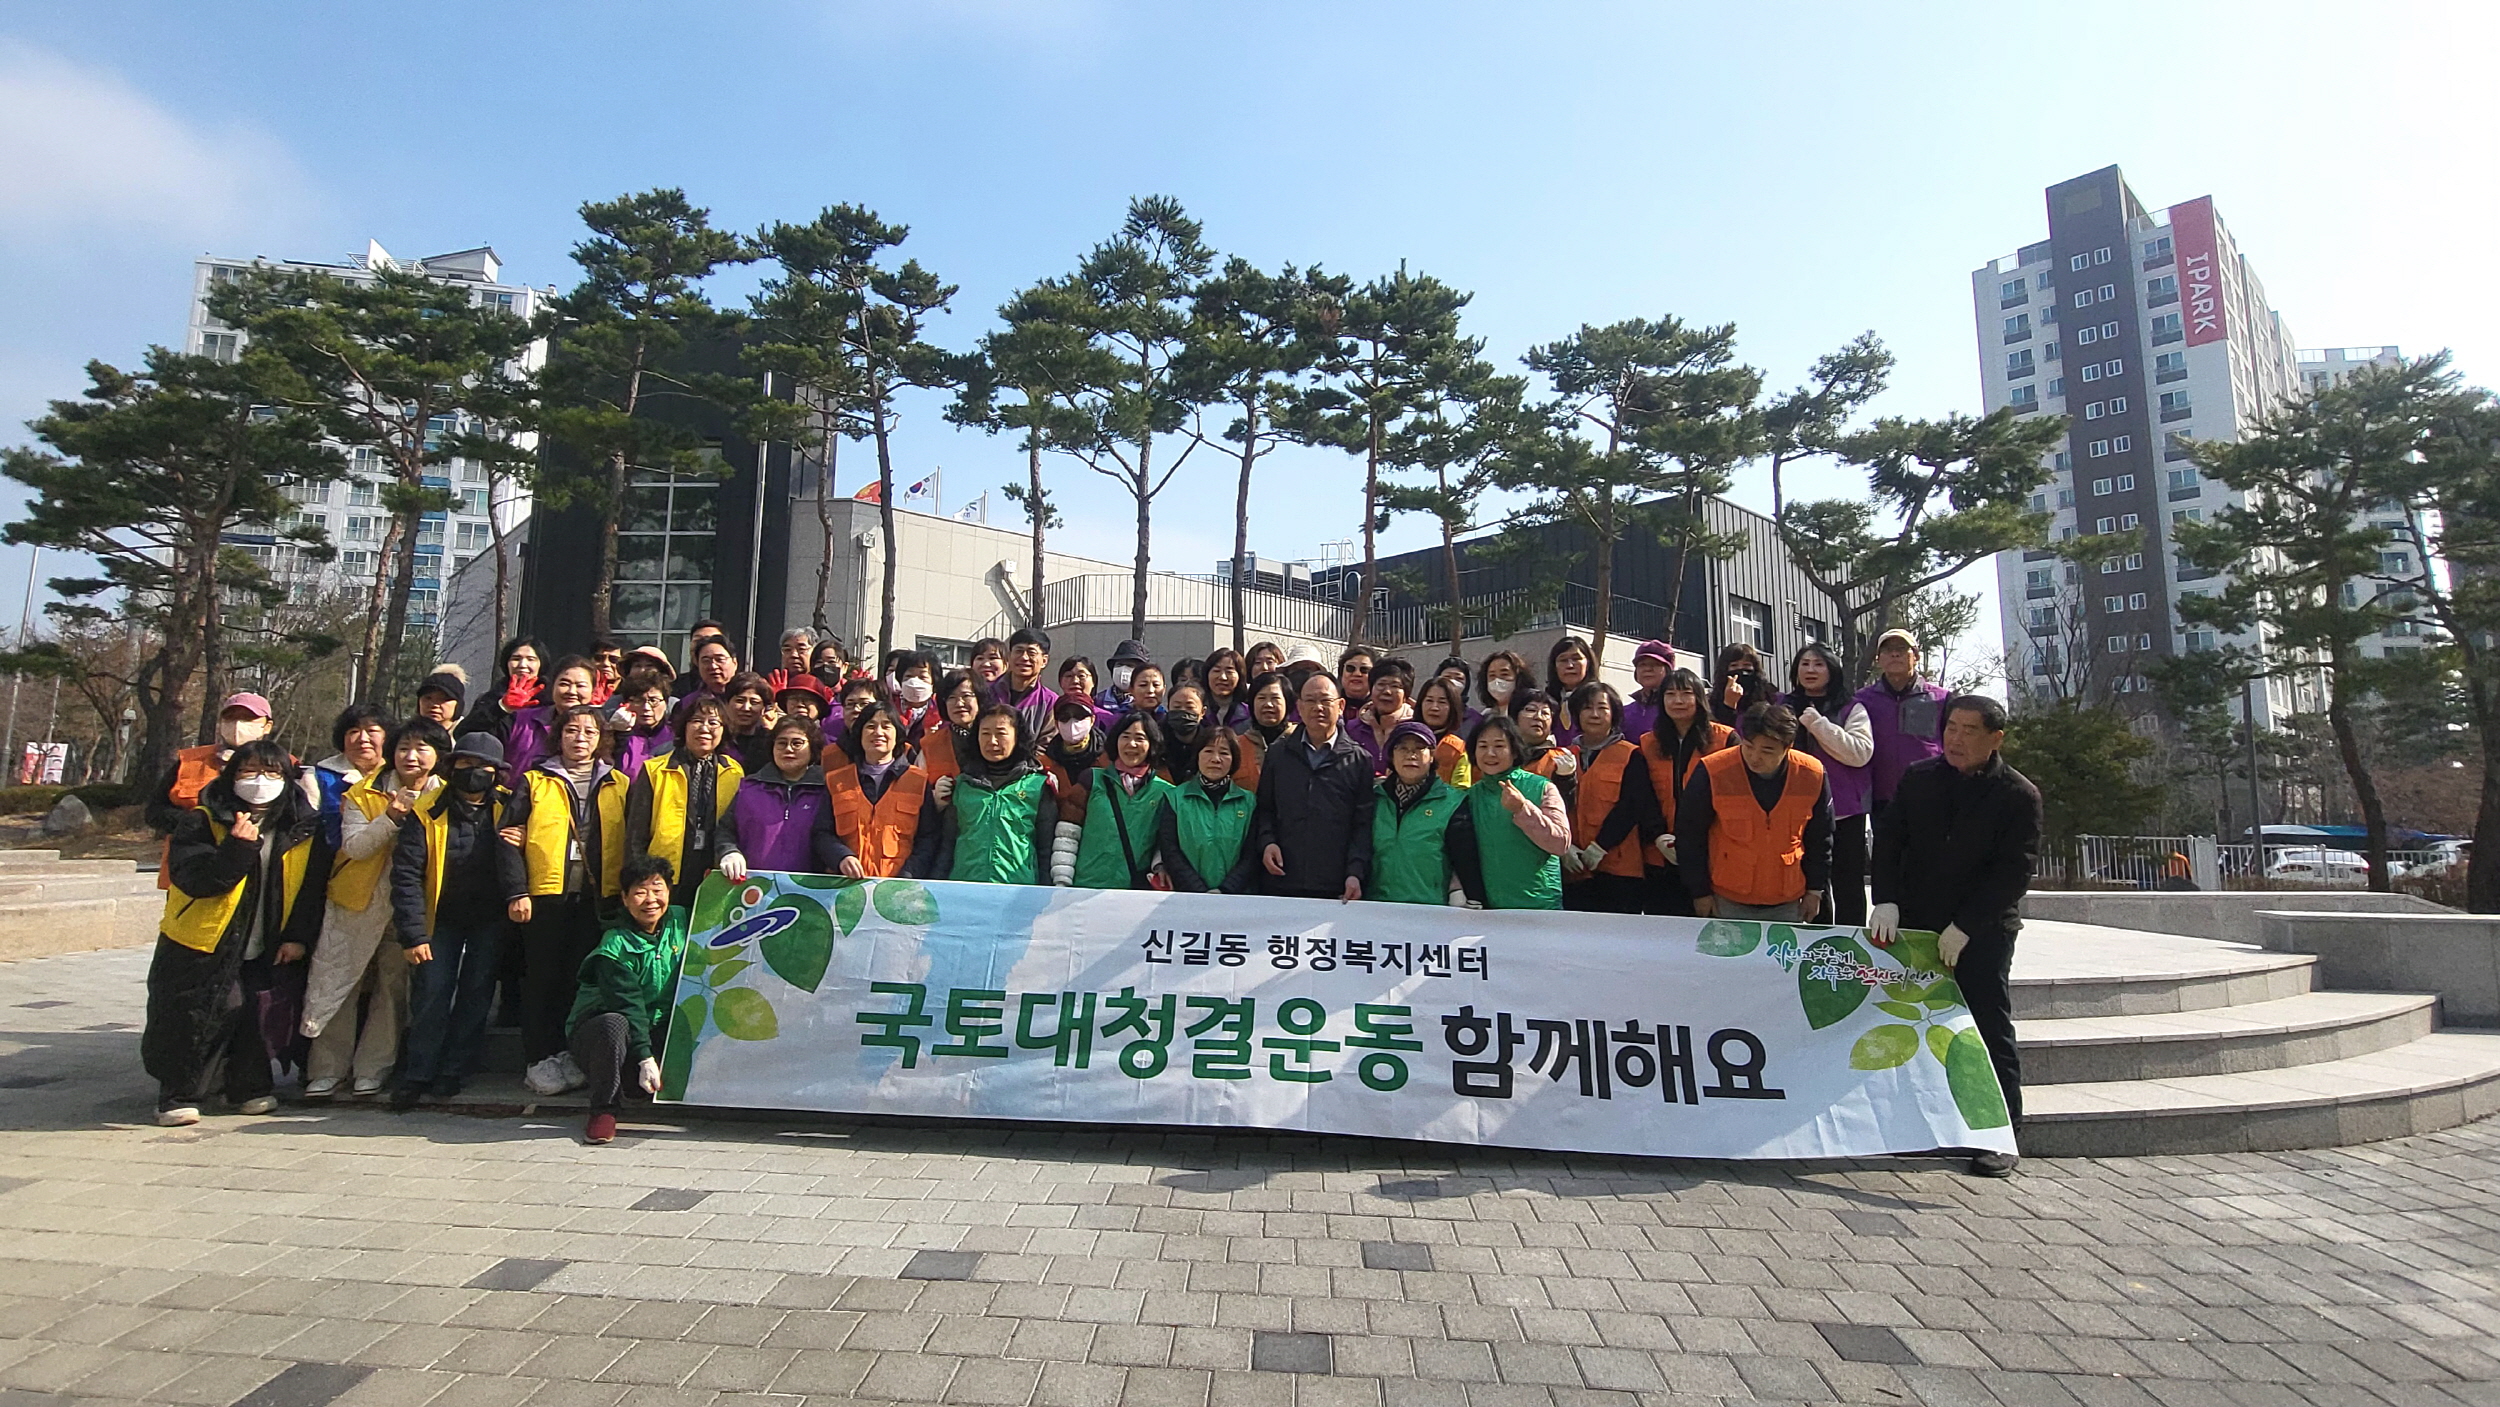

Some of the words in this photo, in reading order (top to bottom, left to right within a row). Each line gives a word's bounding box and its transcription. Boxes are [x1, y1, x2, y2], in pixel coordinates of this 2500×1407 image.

[2186, 252, 2217, 334] IPARK
[1140, 929, 1251, 967] 신길동
[1267, 935, 1490, 981] 행정복지센터
[855, 981, 1424, 1092] 국토대청결운동
[1440, 1005, 1787, 1106] 함께해요
